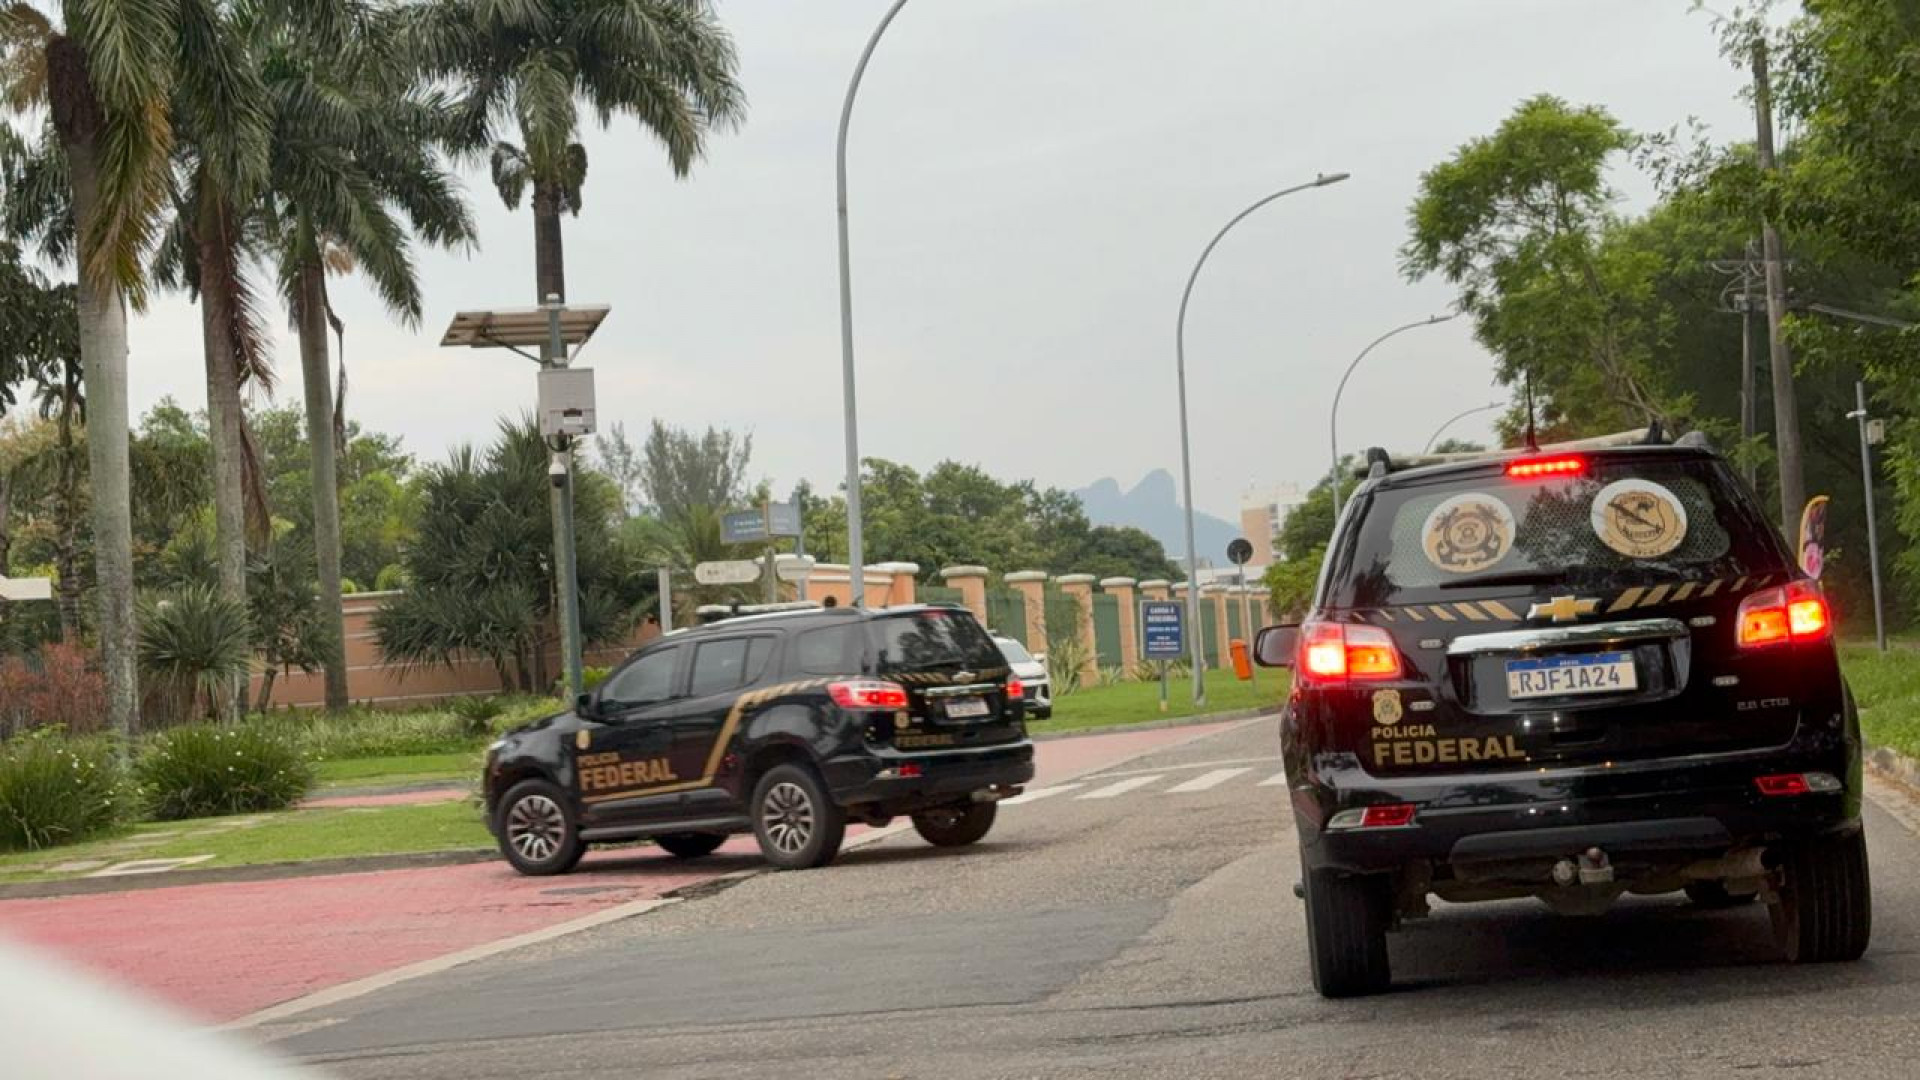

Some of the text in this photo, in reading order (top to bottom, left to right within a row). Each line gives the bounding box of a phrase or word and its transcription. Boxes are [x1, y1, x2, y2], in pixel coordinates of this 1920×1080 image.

[1520, 665, 1621, 693] RJF1A24
[1371, 724, 1437, 739] POLICIA
[1374, 735, 1526, 766] FEDERAL
[580, 757, 679, 791] FEDERAL
